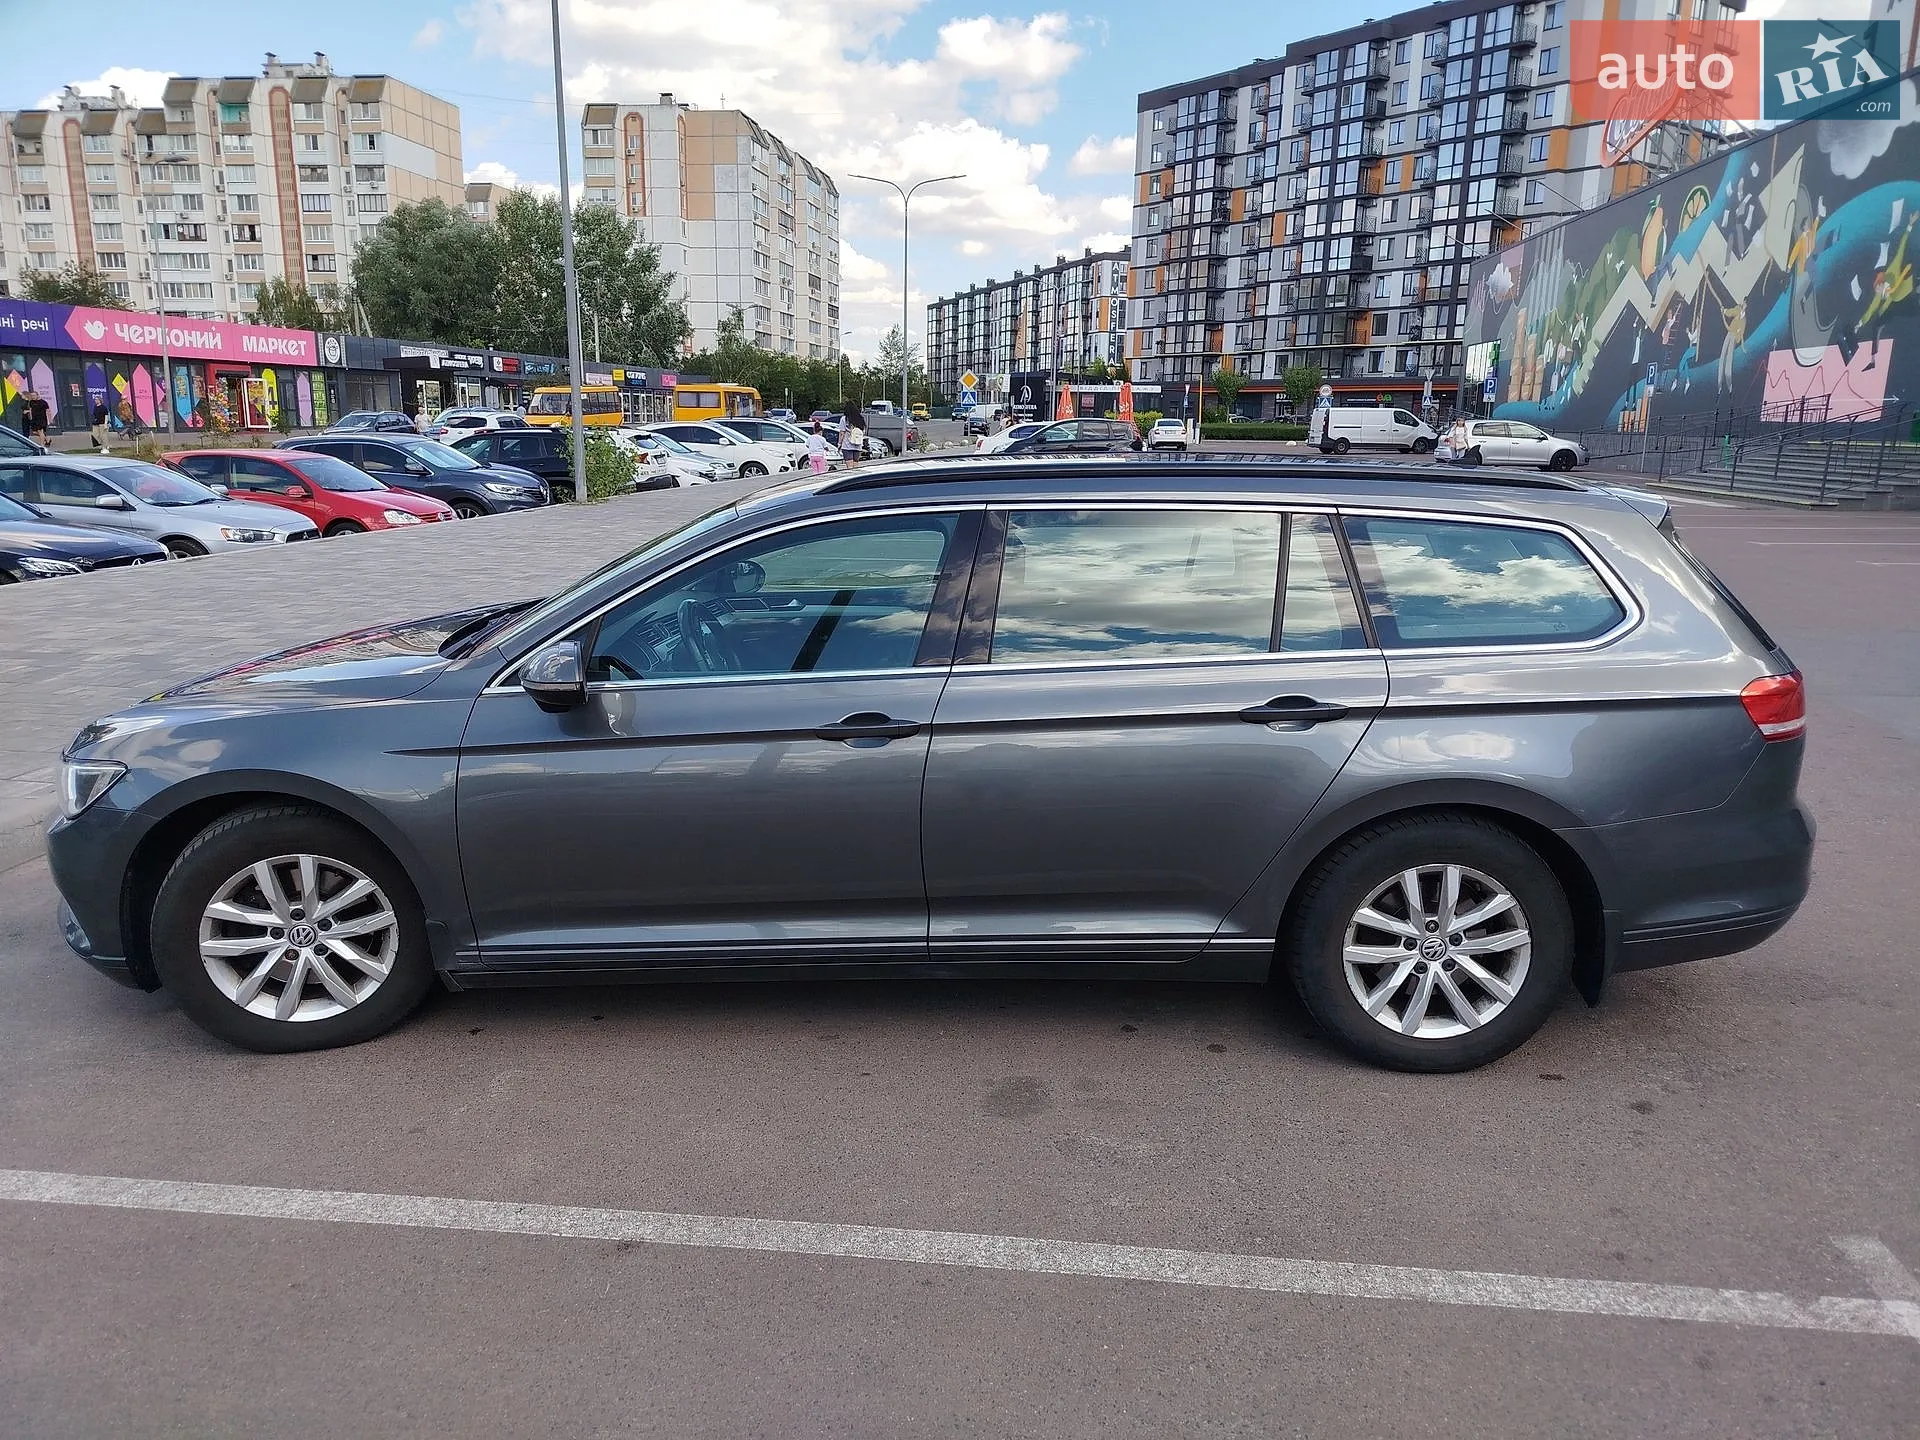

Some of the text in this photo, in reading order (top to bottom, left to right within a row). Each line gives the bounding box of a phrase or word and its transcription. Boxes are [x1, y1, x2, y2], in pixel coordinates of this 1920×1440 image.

[0, 313, 49, 332] ні речі
[1108, 262, 1120, 366] ATMOSFERA
